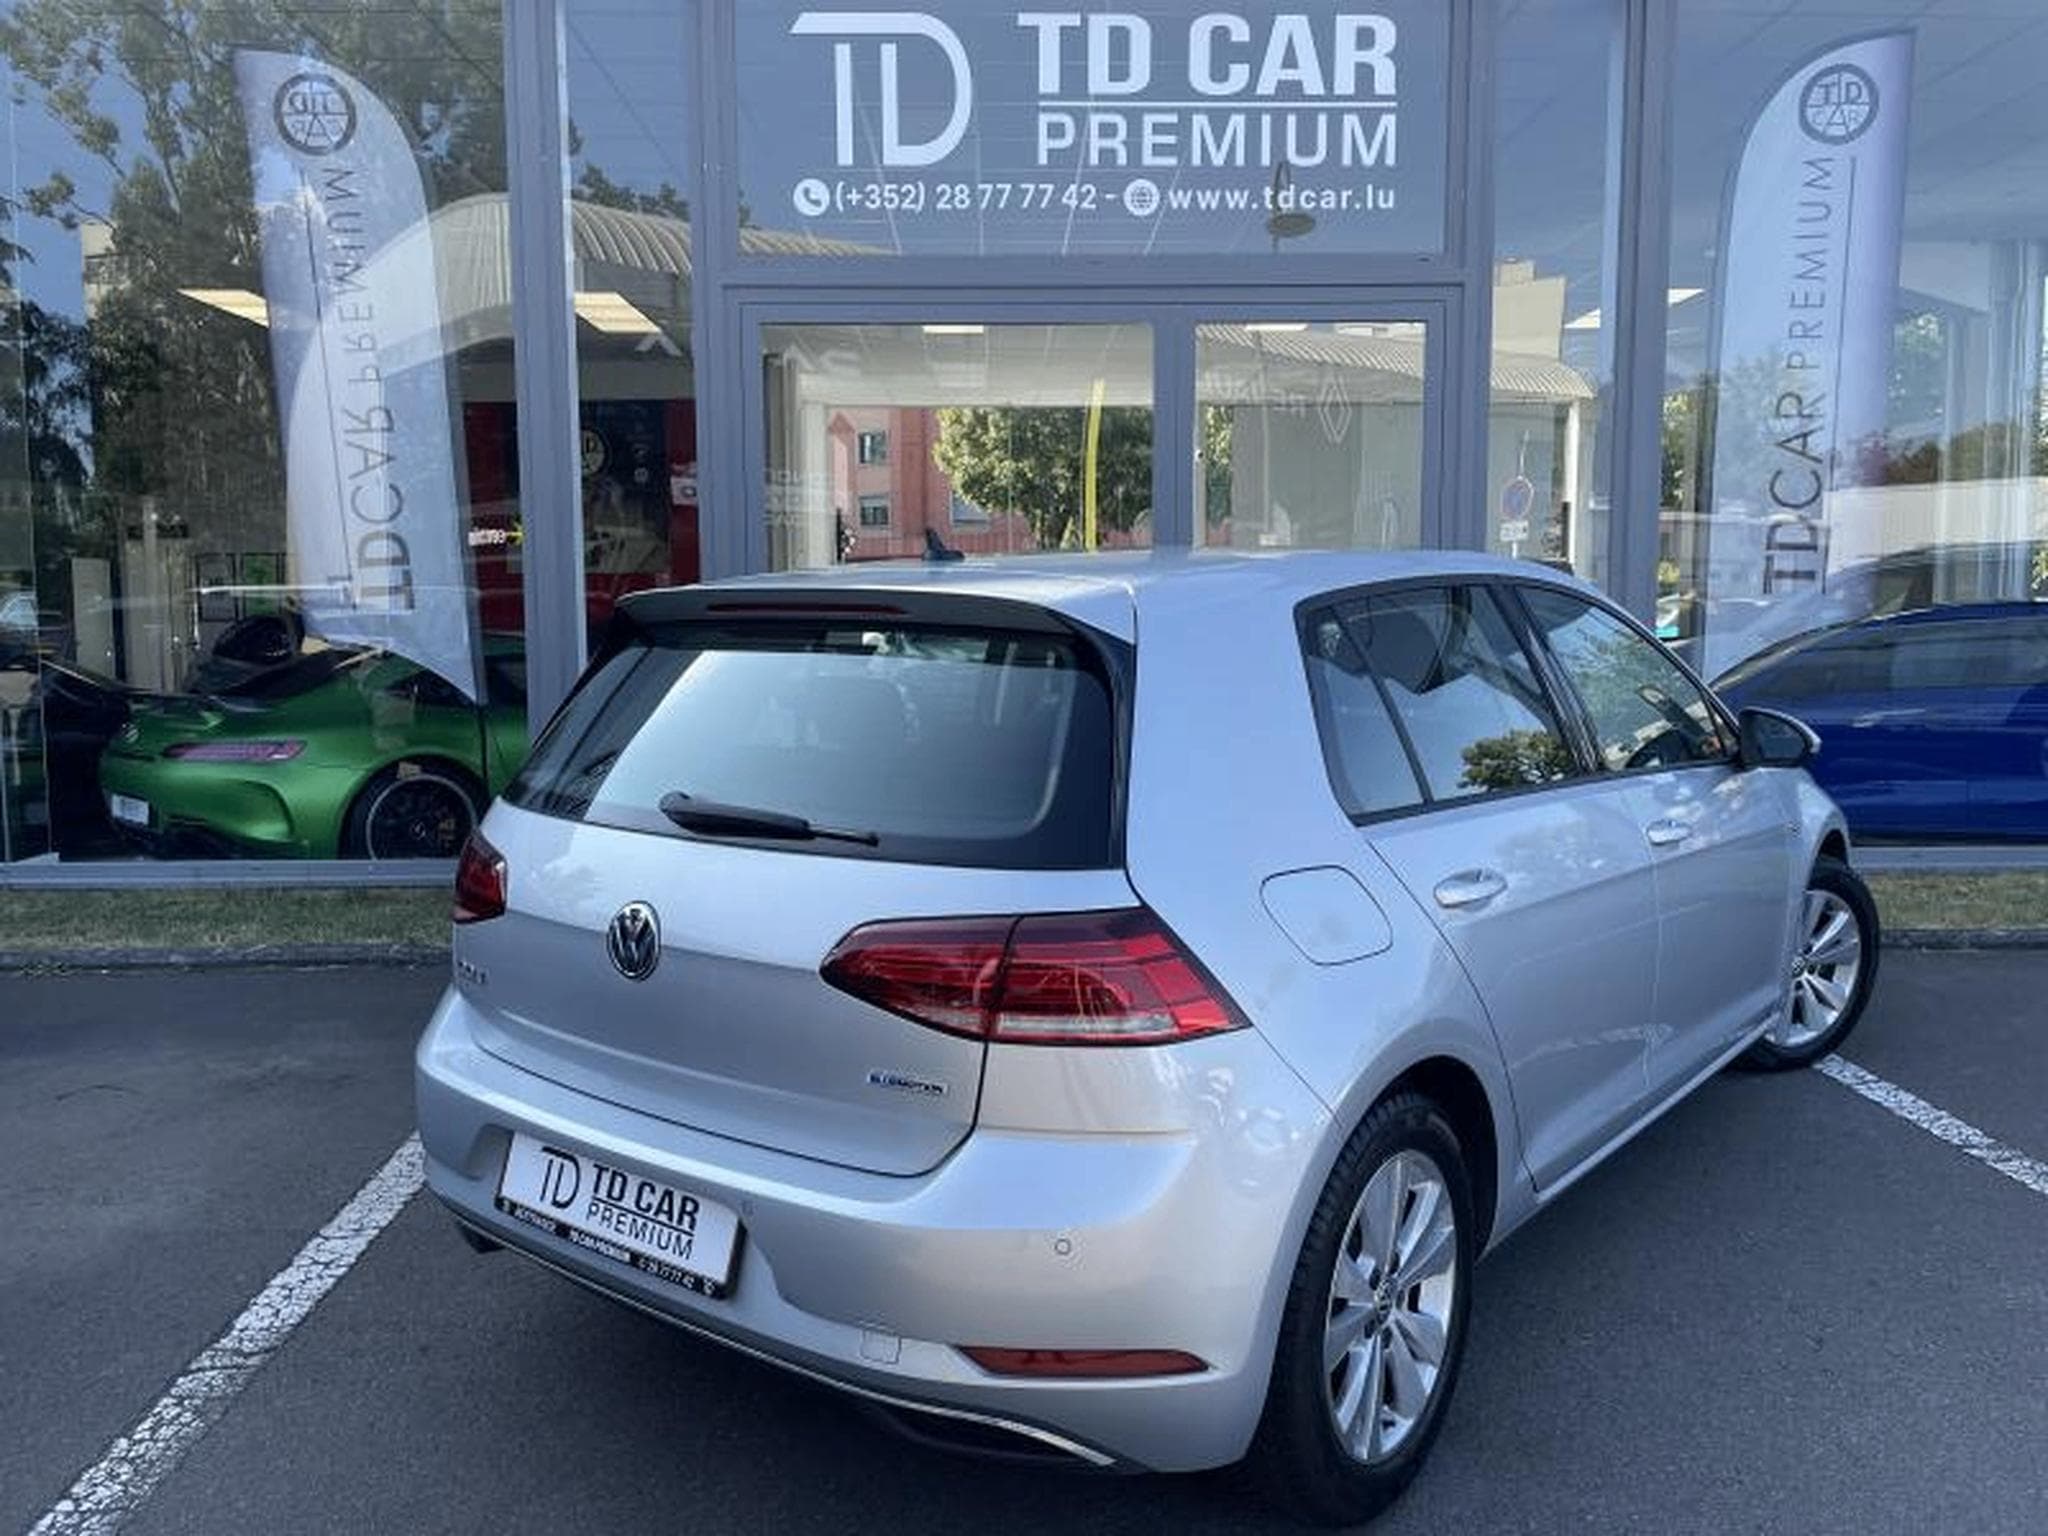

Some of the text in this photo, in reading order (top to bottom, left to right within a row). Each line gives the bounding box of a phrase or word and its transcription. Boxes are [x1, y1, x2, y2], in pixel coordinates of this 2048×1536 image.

[1017, 12, 1397, 96] TD CAR
[1037, 112, 1397, 167] PREMIUM
[835, 181, 926, 213] (+352)
[935, 183, 971, 210] 28
[977, 183, 1013, 210] 77
[1019, 183, 1055, 210] 77
[1060, 183, 1098, 210] 42
[1168, 183, 1396, 210] www.tdcar.lu
[1786, 156, 1835, 370] PREMIUM
[593, 1163, 700, 1232] TD CAR
[586, 1201, 694, 1260] PREMIUM
